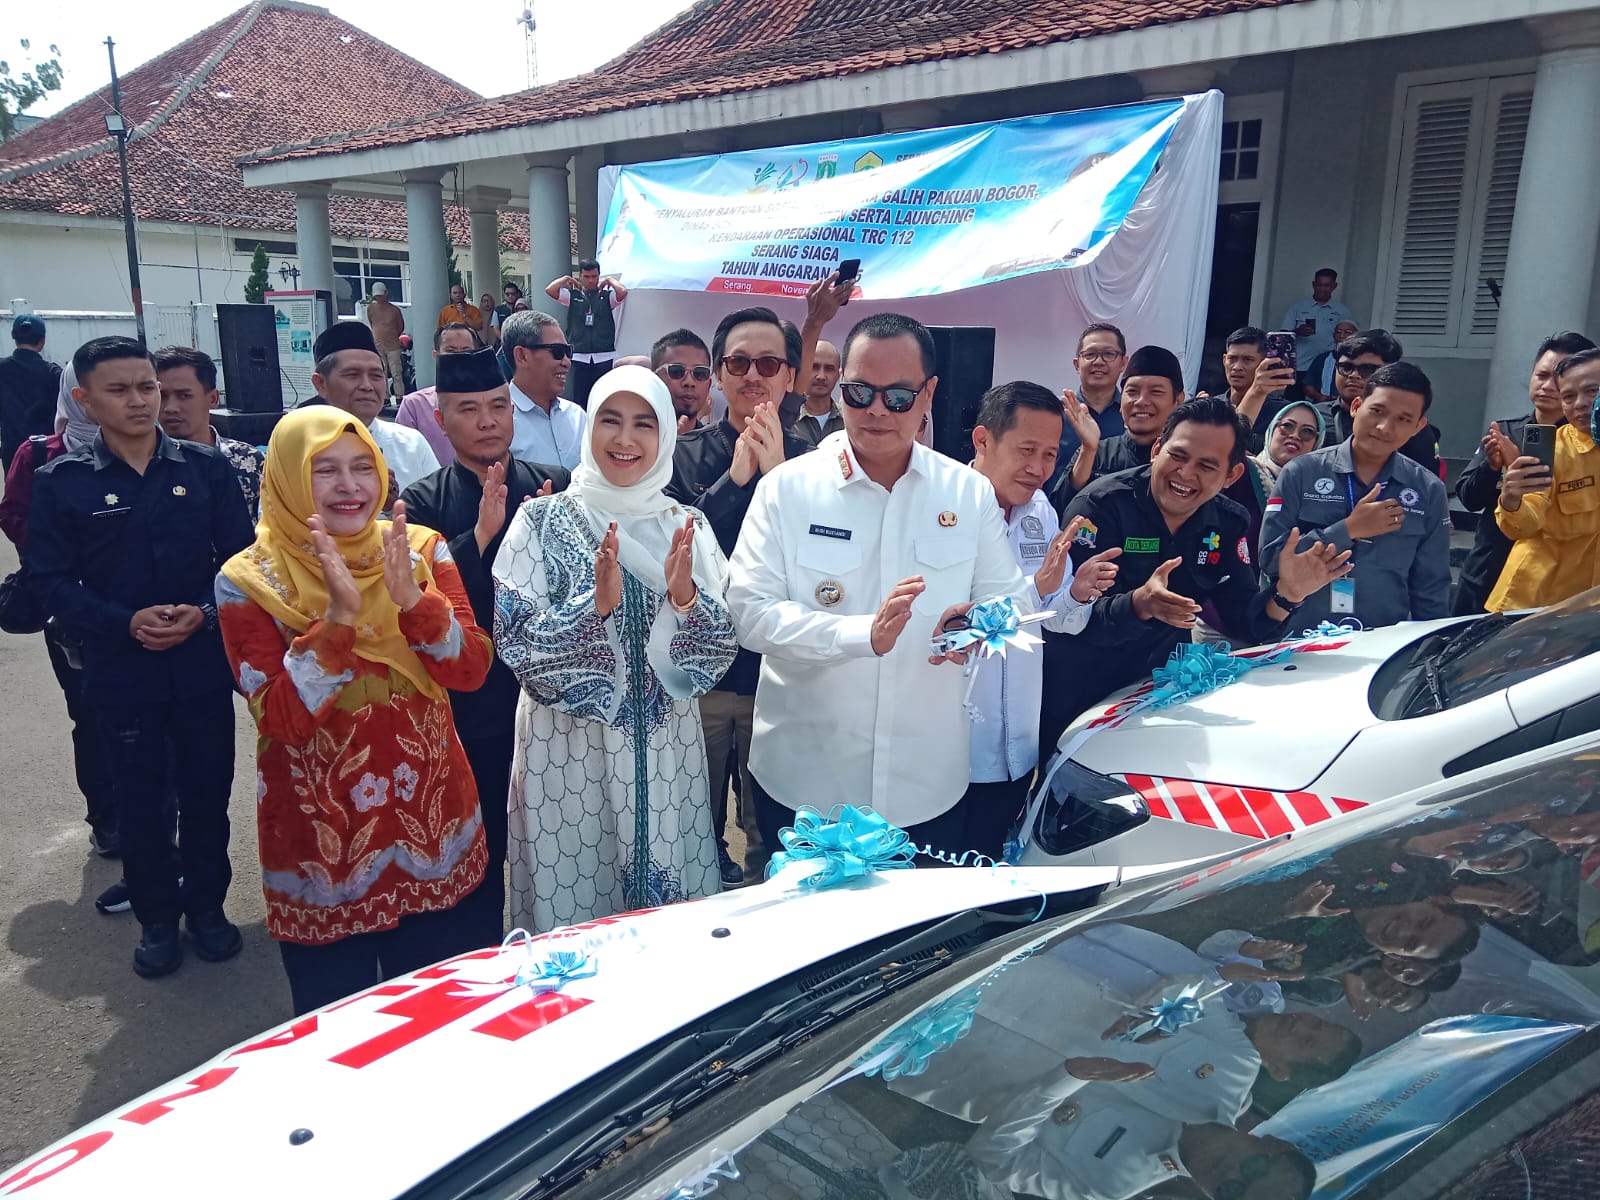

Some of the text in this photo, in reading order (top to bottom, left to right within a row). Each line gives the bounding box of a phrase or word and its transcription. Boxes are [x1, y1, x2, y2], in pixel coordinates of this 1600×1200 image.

[881, 188, 926, 206] GALIH
[926, 187, 984, 206] PAKUAN
[715, 204, 762, 216] BANTUAN
[848, 207, 892, 225] SERTA
[893, 208, 976, 226] LAUNCHING
[707, 226, 915, 246] KENDARAAN OPERASIONAL TRC 112
[751, 244, 839, 262] SERANG SIAGA
[720, 261, 759, 277] TAHUN
[760, 262, 831, 282] ANGGARAN
